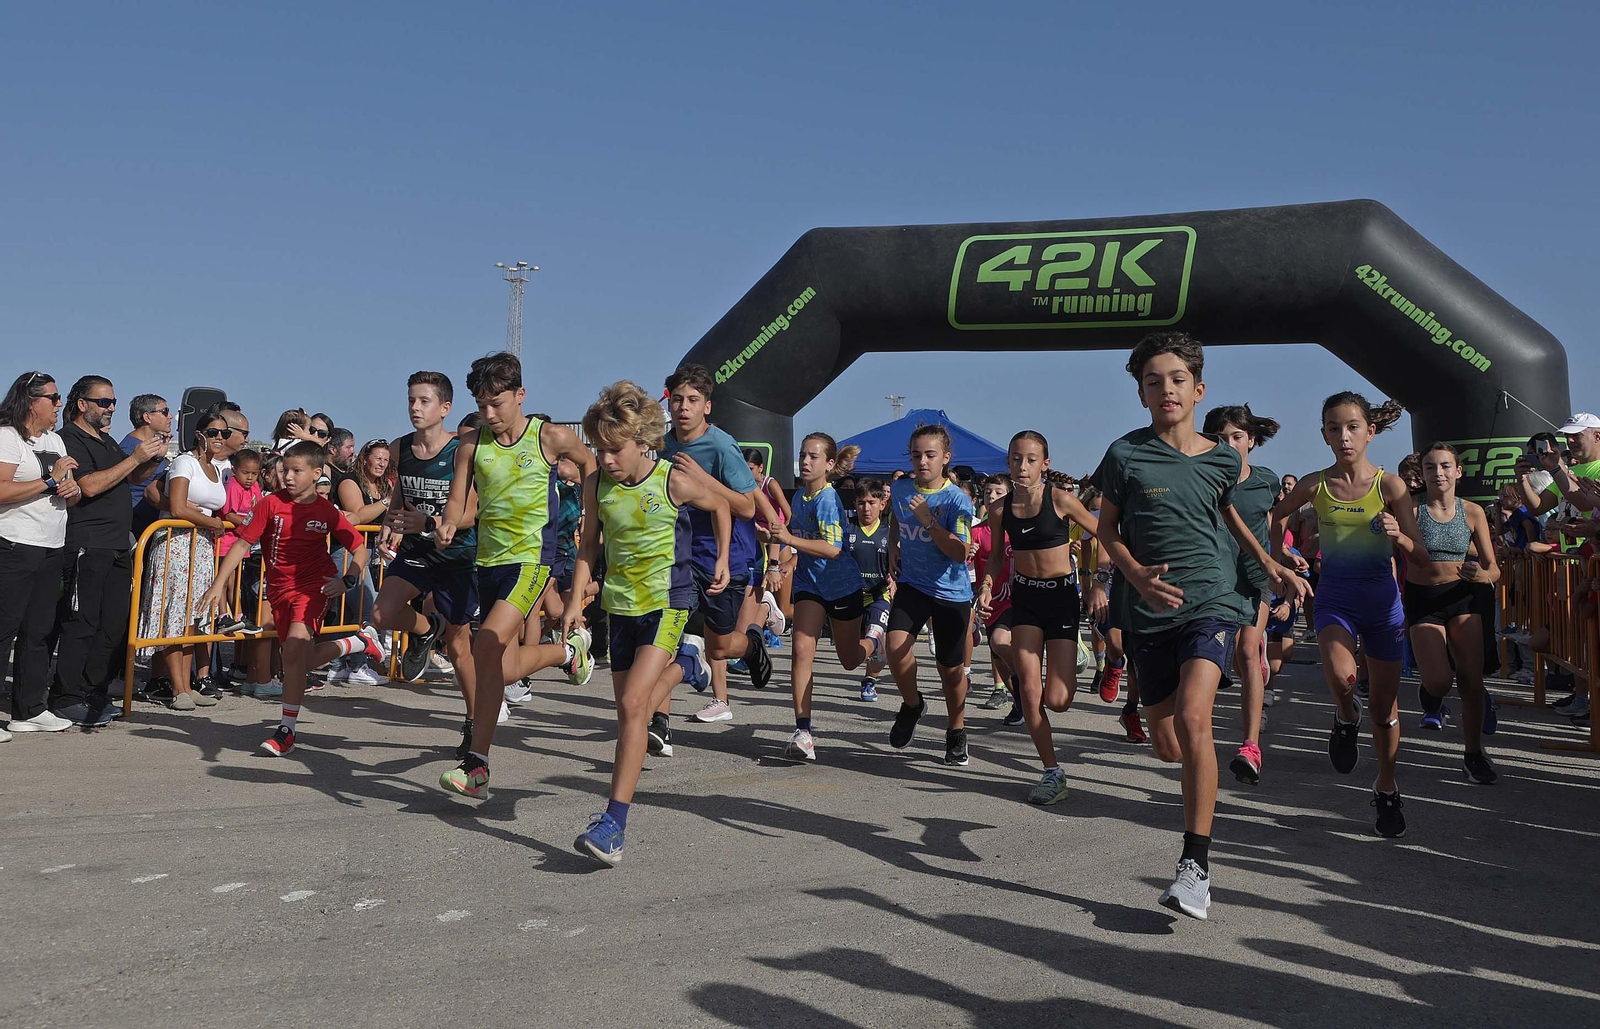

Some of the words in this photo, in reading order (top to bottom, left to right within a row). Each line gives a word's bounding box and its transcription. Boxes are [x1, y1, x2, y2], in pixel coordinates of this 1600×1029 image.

[976, 239, 1164, 292] 42K
[1032, 296, 1049, 306] TM
[1051, 288, 1153, 317] running
[1354, 264, 1492, 372] 42krunning.com
[714, 286, 817, 385] 42krunning.com
[306, 520, 328, 530] CPA
[1028, 580, 1058, 589] PRO
